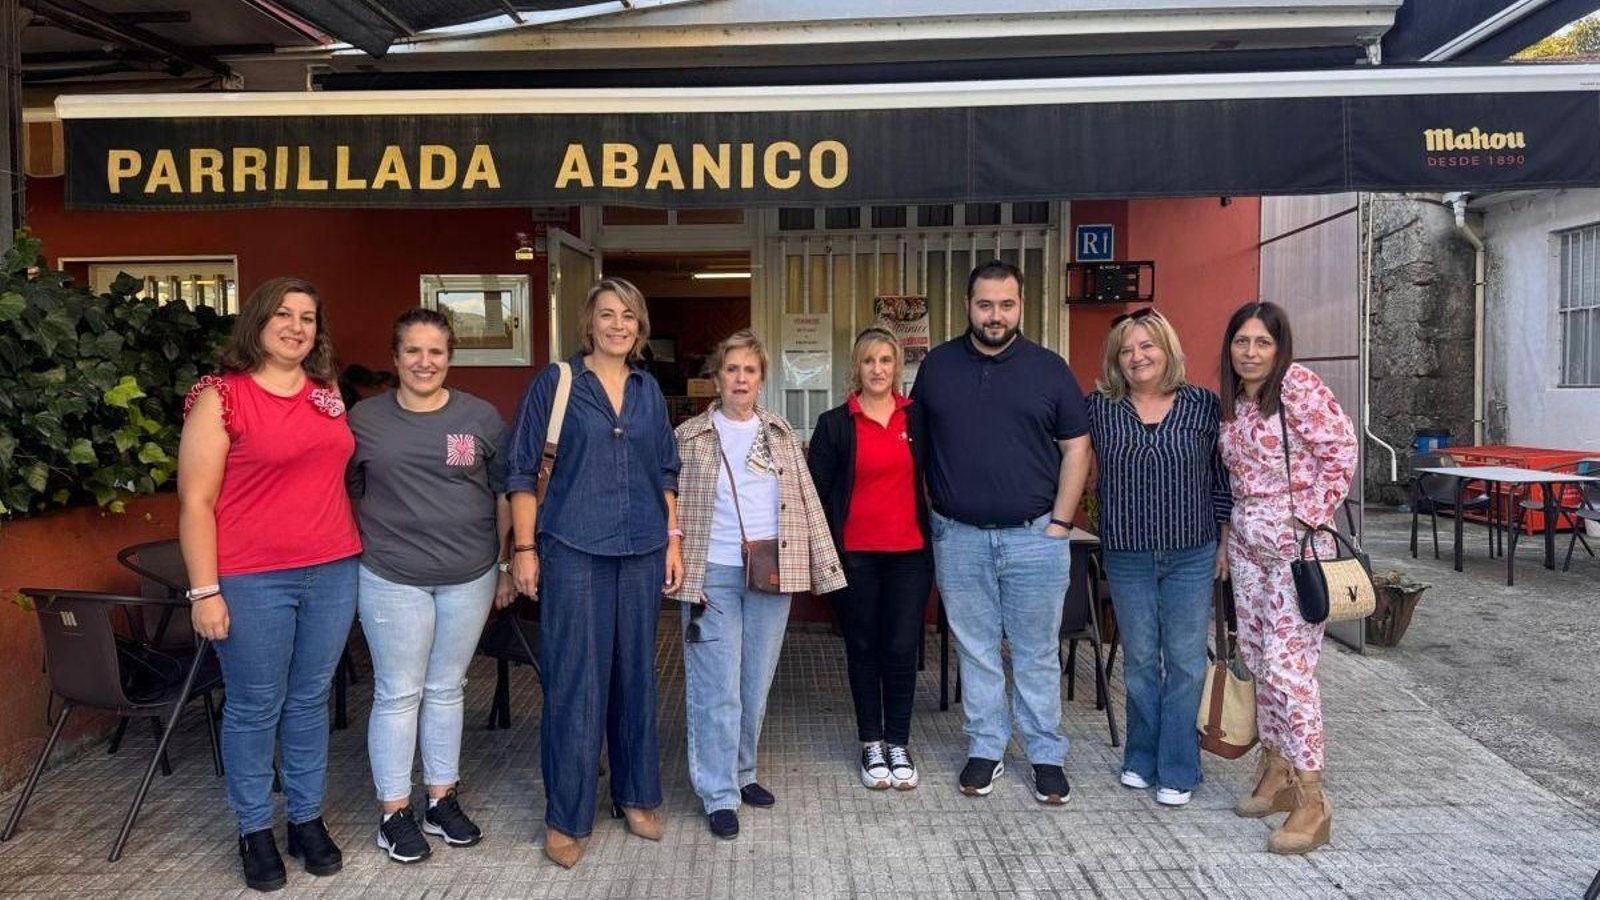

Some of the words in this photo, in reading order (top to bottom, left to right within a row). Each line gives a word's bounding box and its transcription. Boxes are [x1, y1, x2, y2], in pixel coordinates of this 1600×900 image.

[1423, 126, 1526, 151] Mahou
[107, 144, 501, 194] PARRILLADA
[555, 139, 849, 190] ABANICO
[1427, 156, 1480, 166] DESDE
[1488, 155, 1525, 166] 1890
